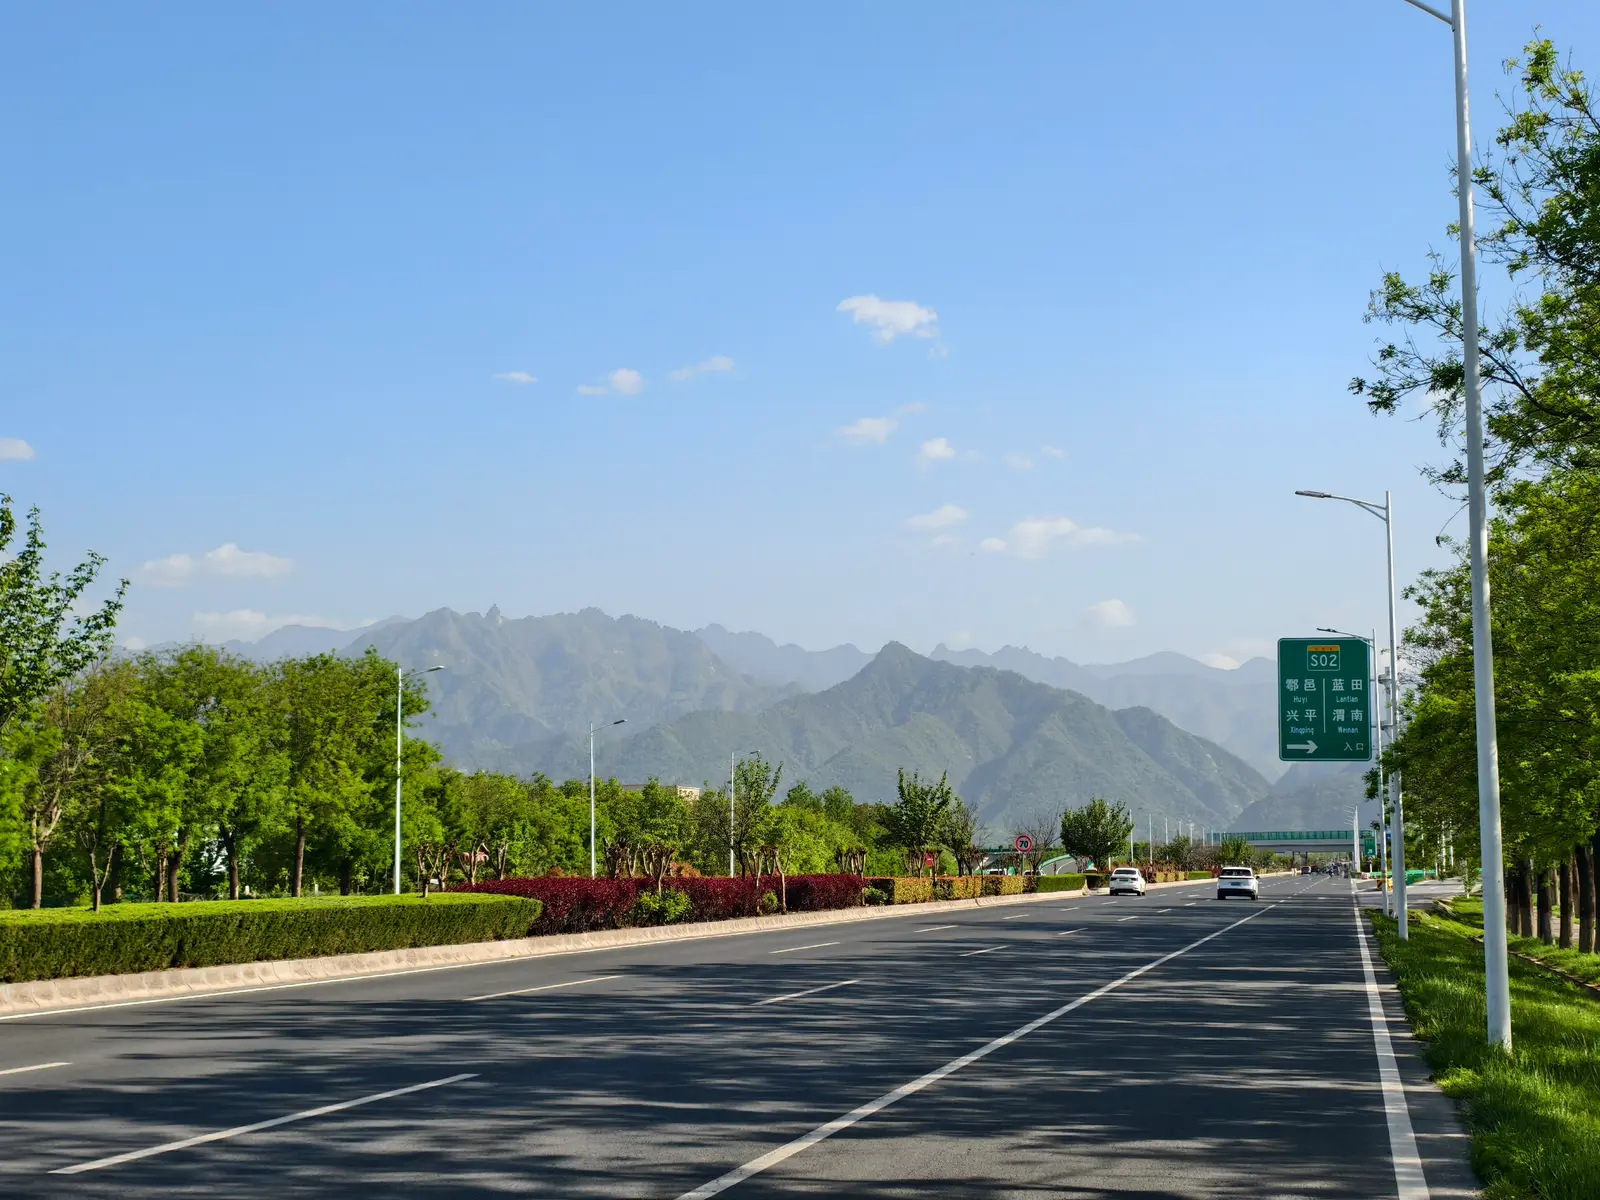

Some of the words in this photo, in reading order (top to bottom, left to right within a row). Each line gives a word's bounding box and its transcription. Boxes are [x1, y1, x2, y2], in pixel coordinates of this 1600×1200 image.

[1310, 654, 1338, 666] S02
[1286, 678, 1316, 692] 鄂邑
[1332, 678, 1362, 690] 蓝田
[1294, 696, 1308, 704] Huyi
[1286, 709, 1317, 722] 兴平
[1332, 709, 1364, 722] 渭南
[1290, 726, 1314, 735] Xingping
[1344, 742, 1364, 751] 入口
